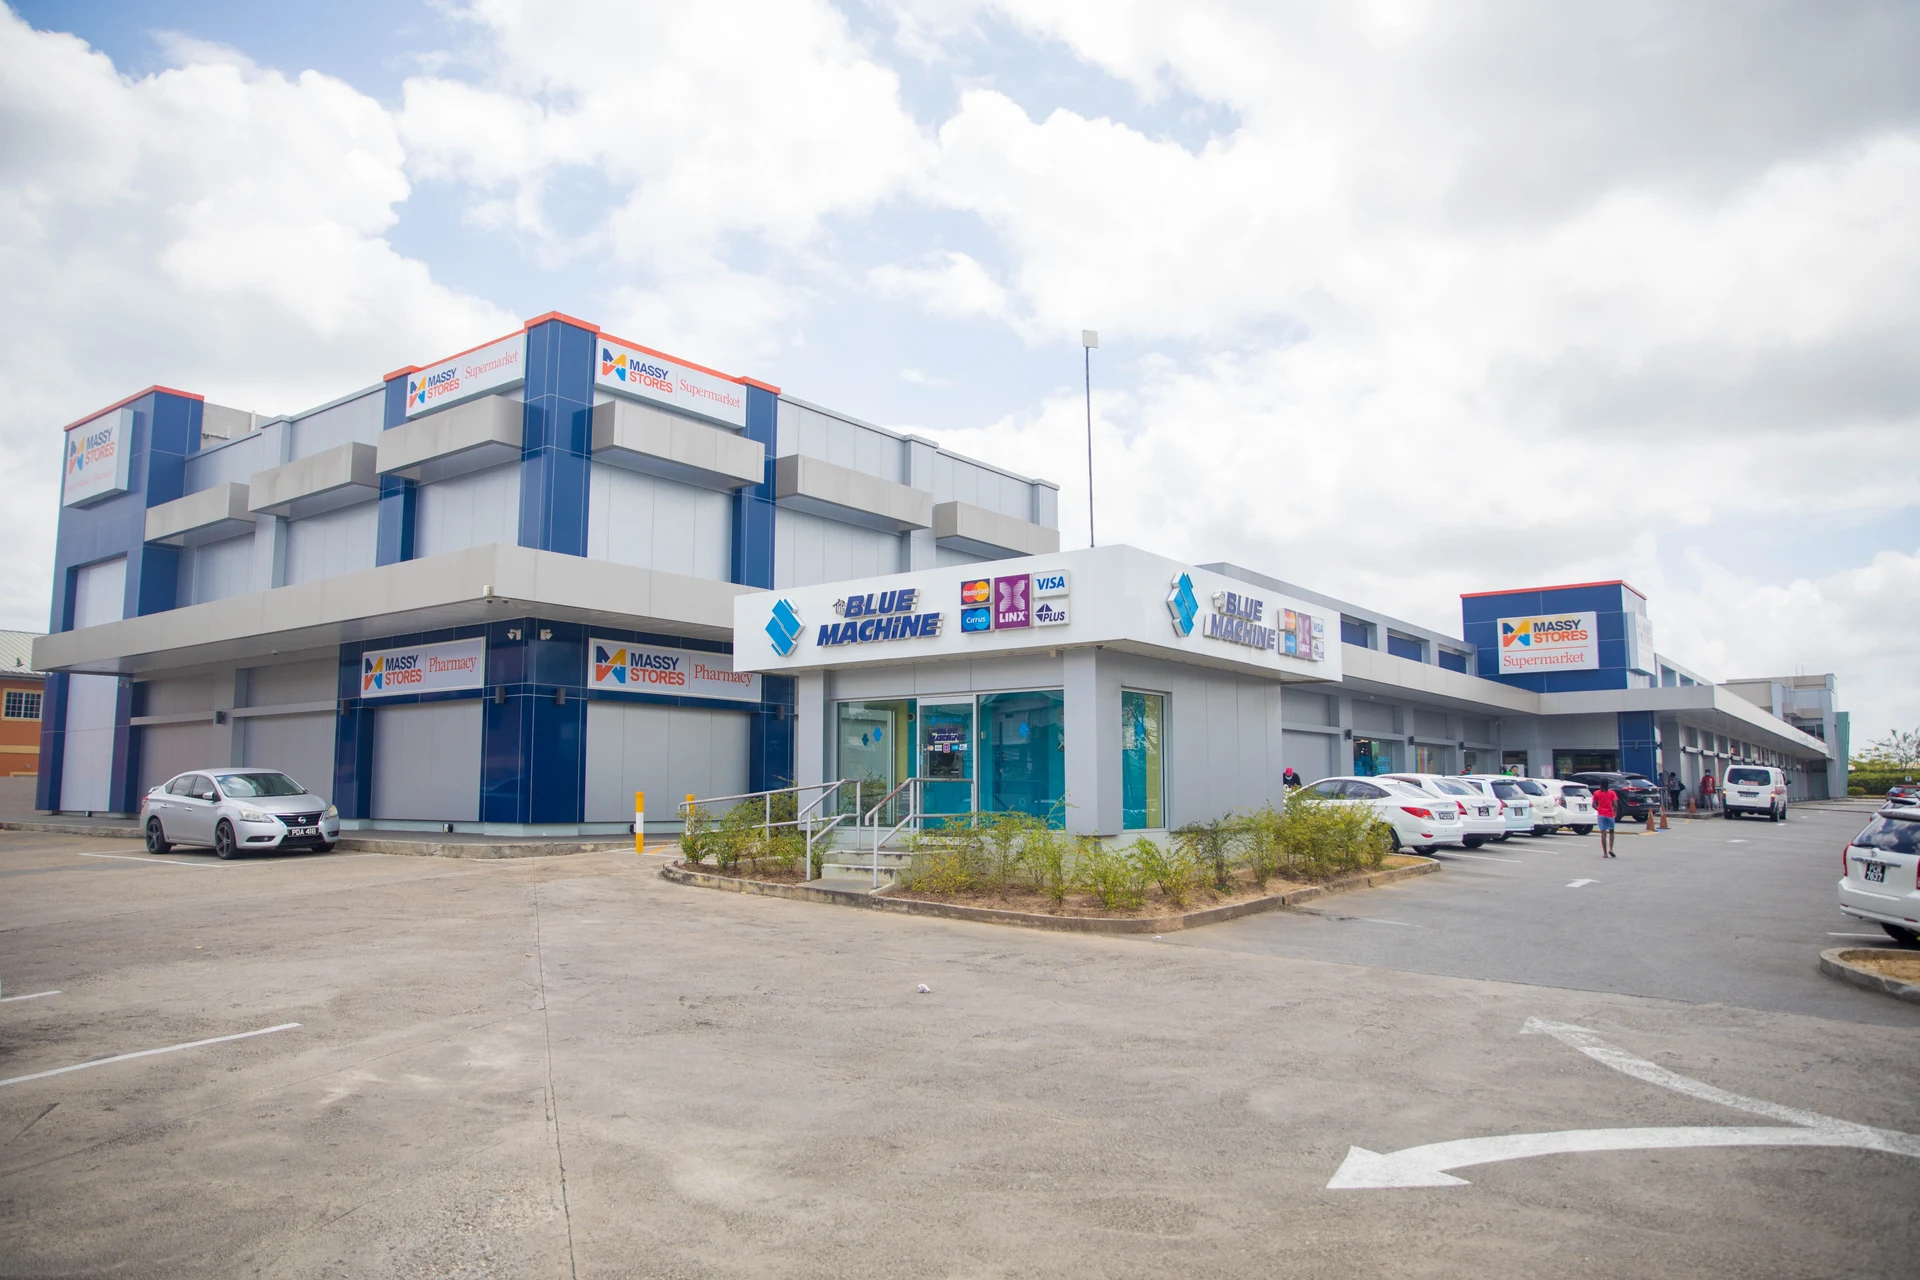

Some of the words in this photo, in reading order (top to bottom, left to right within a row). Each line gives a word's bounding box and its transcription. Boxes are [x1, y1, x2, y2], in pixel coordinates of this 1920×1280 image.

[465, 350, 518, 379] Supermarket
[630, 359, 669, 380] MASSY
[428, 367, 457, 388] MASSY
[629, 371, 673, 393] STORES
[427, 378, 460, 399] STORES
[680, 379, 741, 409] Supermarket
[86, 427, 113, 451] MASSY
[84, 441, 115, 465] STORES
[1036, 576, 1065, 590] VISA
[963, 588, 990, 597] MasterCard
[844, 588, 918, 618] BLUE
[1226, 592, 1263, 621] BLUE
[1000, 611, 1025, 623] LINX
[1043, 611, 1065, 622] PLUS
[1534, 619, 1581, 633] MASSY
[1534, 629, 1588, 643] STORES
[386, 654, 419, 671] MASSY
[429, 657, 477, 673] Pharmacy
[630, 652, 679, 670] MASSY
[1503, 652, 1585, 668] Supermarket
[385, 669, 422, 685] STORES
[630, 667, 685, 686] STORES
[694, 664, 753, 687] Pharmacy
[1867, 871, 1883, 881] 7637
